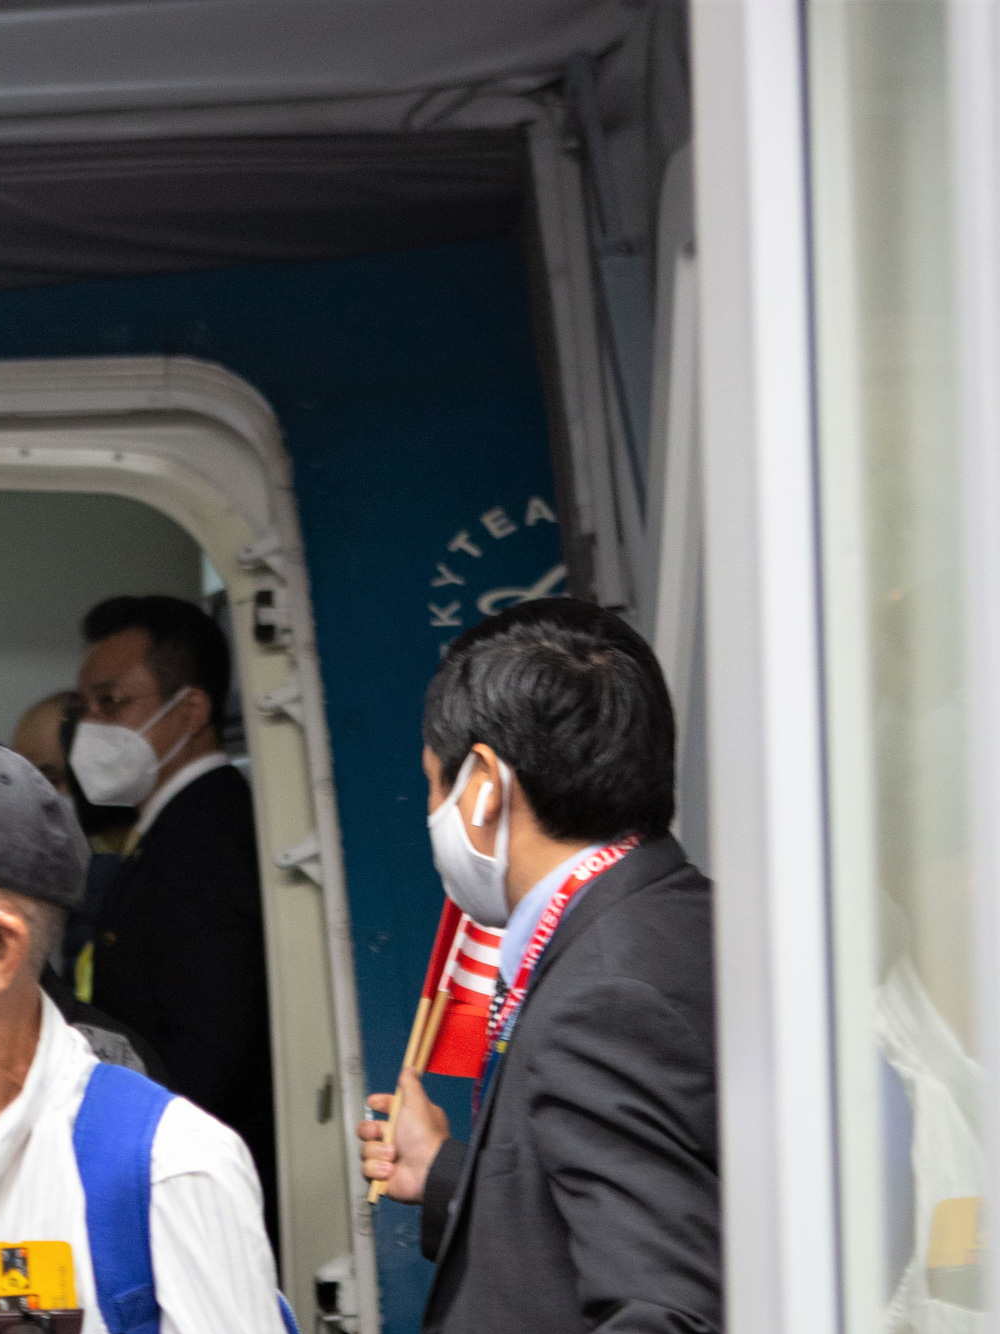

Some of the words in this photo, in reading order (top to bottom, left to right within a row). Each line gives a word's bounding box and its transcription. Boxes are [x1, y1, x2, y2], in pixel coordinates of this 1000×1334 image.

[427, 496, 557, 659] KYTEA
[571, 835, 640, 881] ITOR
[520, 891, 570, 971] VISITOR
